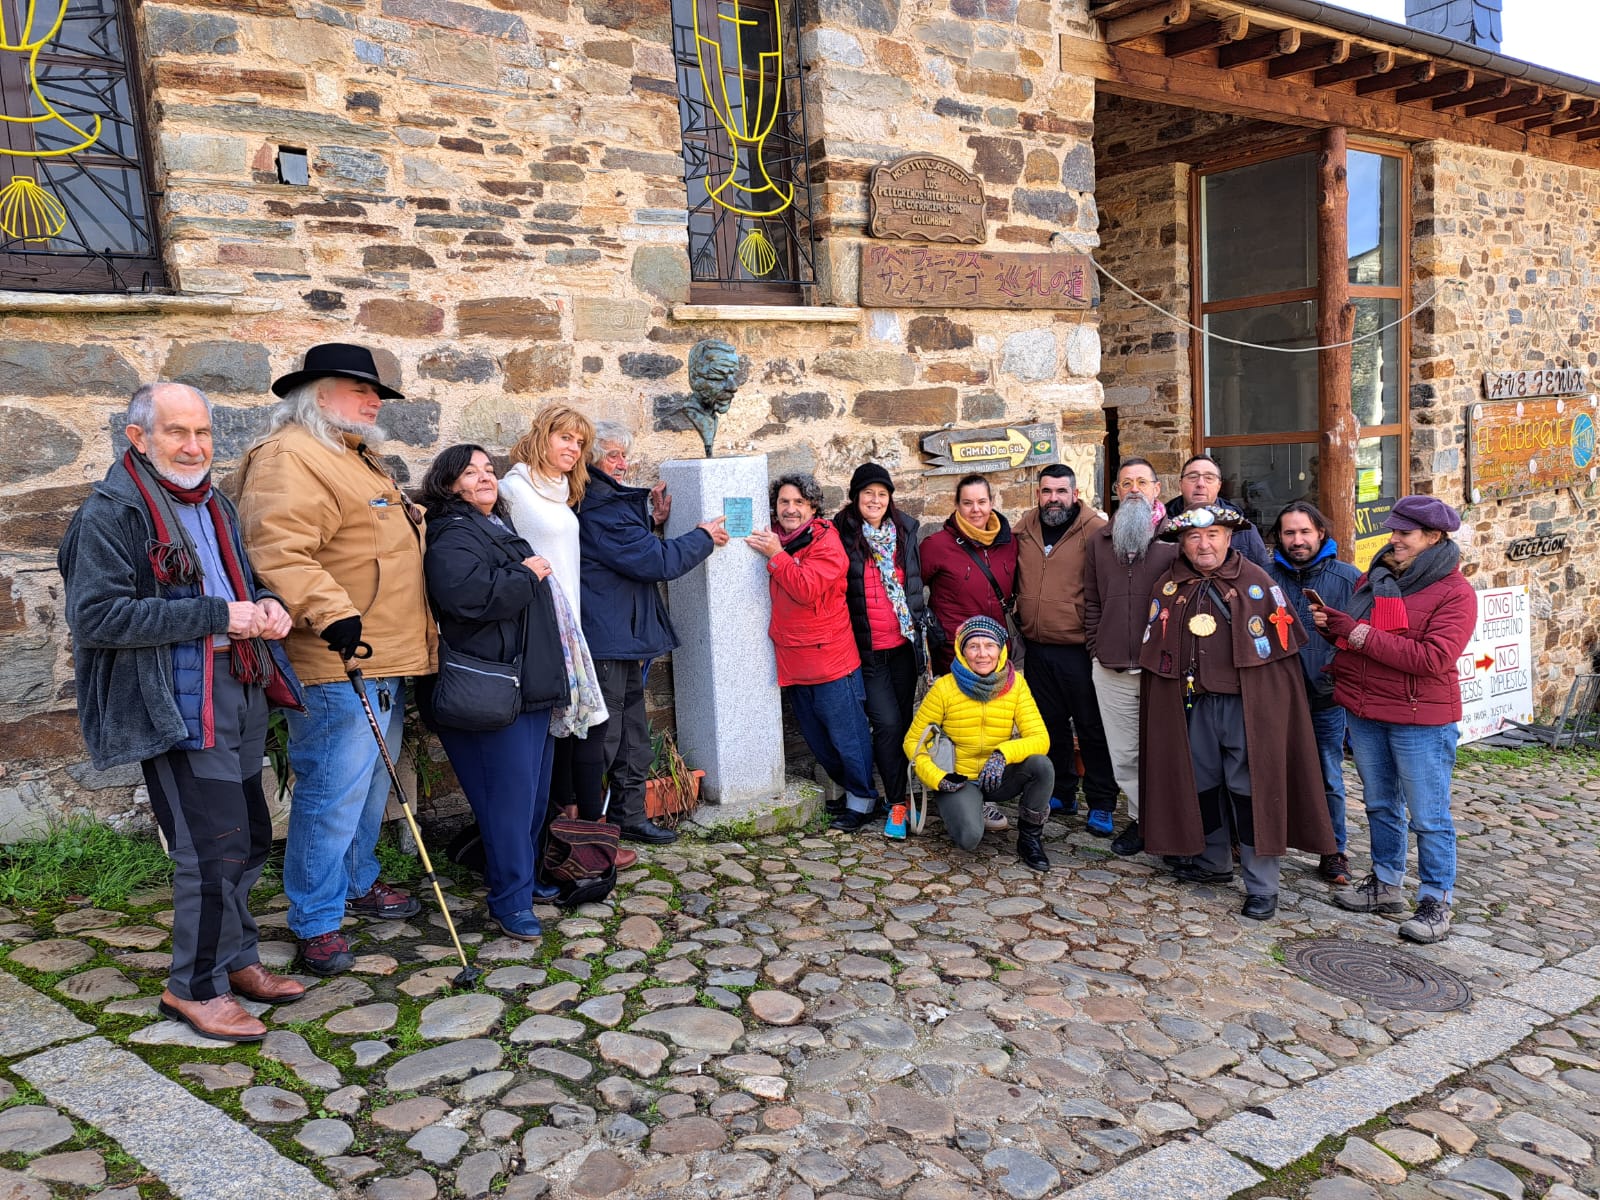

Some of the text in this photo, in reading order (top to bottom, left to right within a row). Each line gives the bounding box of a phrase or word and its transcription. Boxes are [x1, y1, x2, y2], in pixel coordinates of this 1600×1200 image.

[891, 159, 969, 186] HOSPITAL REFUGIO
[926, 170, 936, 178] DE
[924, 180, 939, 190] LOS
[912, 214, 952, 227] COLUMBANO
[948, 204, 963, 215] SAN
[1491, 371, 1527, 397] AVE
[1009, 443, 1025, 453] SOL
[1477, 426, 1495, 455] EL
[1512, 537, 1566, 558] RECEPCION
[1487, 593, 1525, 616] ONG DE
[1482, 617, 1524, 640] PEREGRINO
[1498, 647, 1517, 669] NO
[1490, 668, 1528, 694] IMPUESTOS
